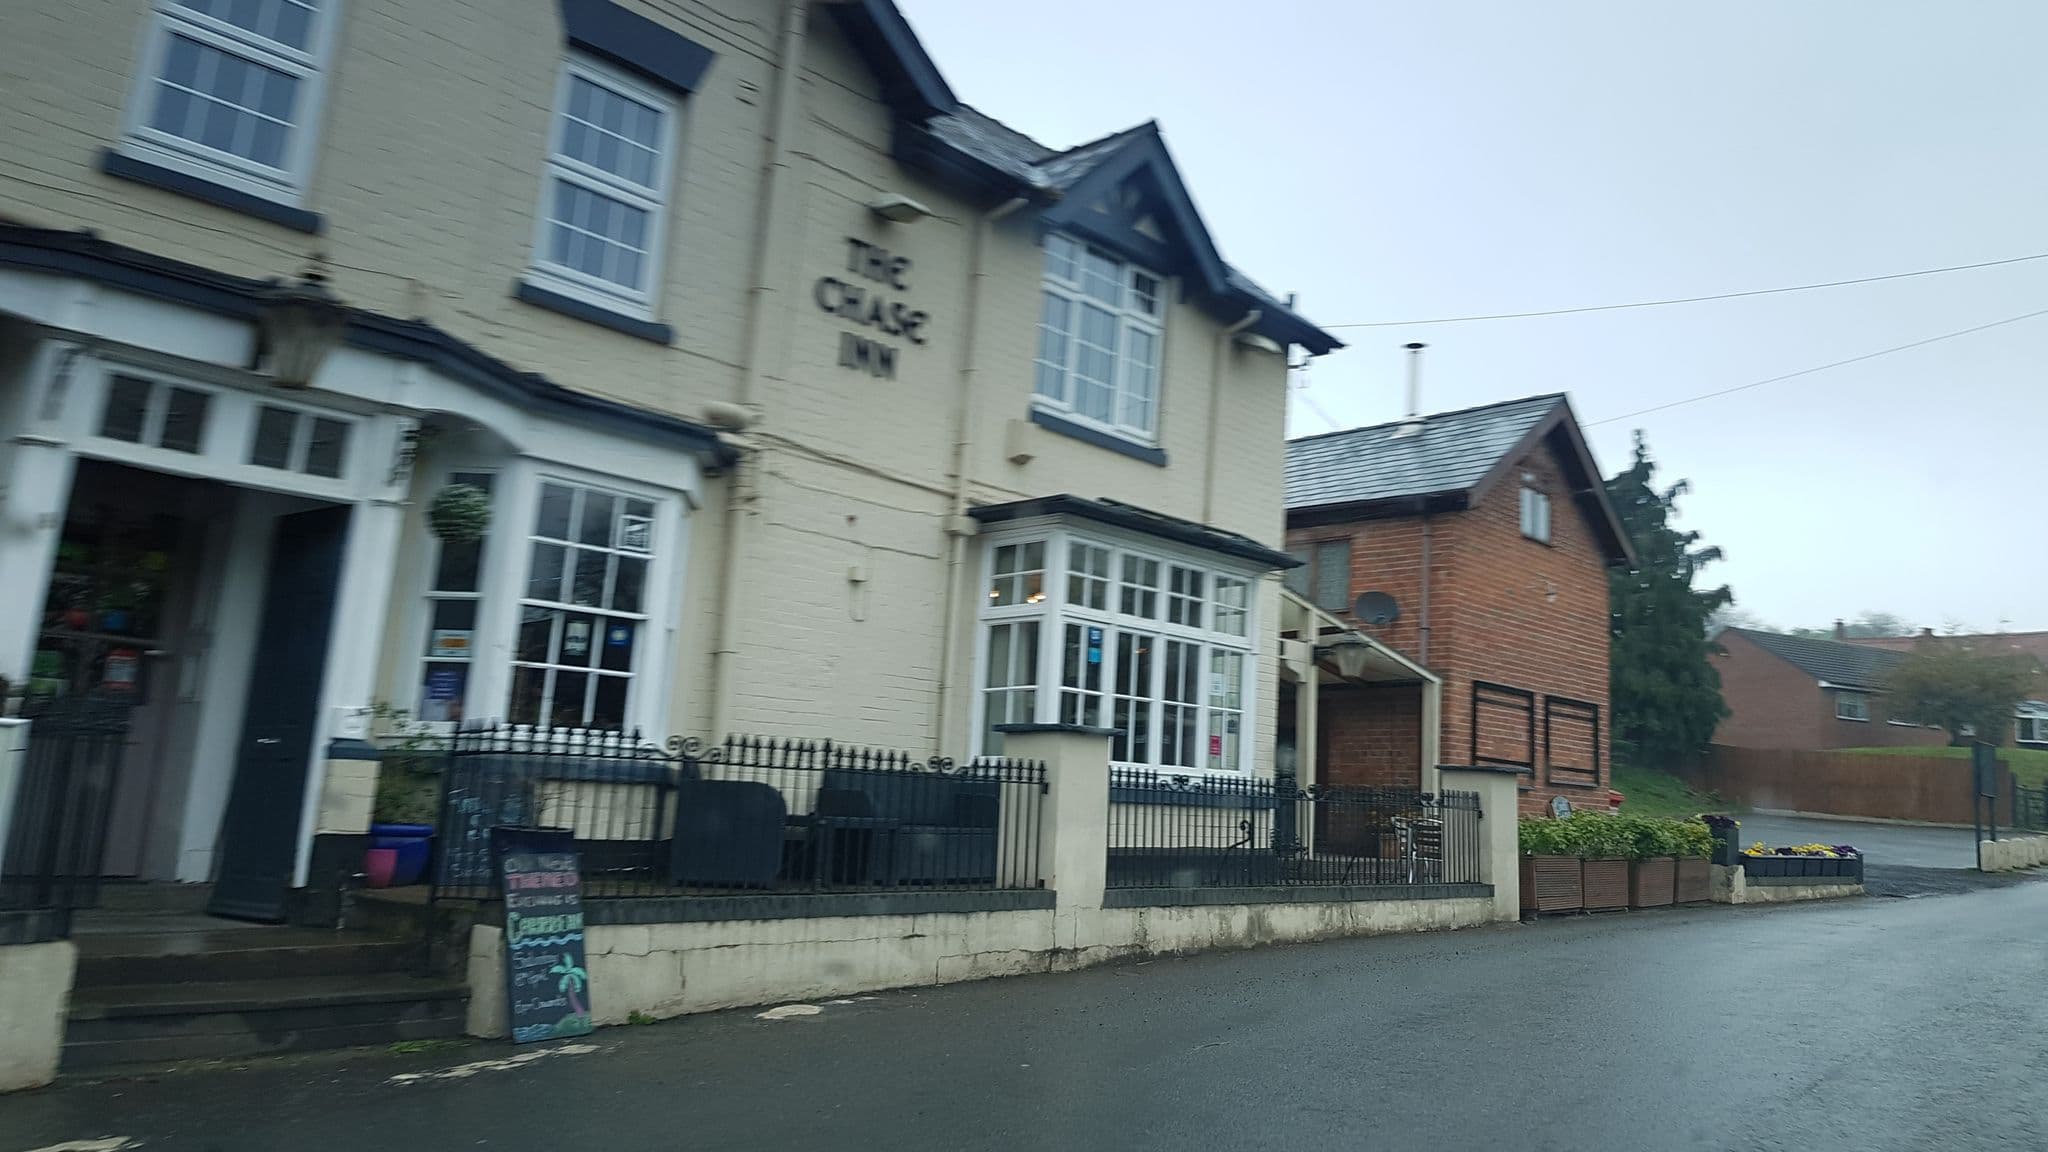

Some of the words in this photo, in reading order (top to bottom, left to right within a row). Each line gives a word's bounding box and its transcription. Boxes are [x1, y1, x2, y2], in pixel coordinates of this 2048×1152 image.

[845, 236, 913, 291] THE
[813, 276, 930, 345] CHASE
[837, 330, 899, 380] INN
